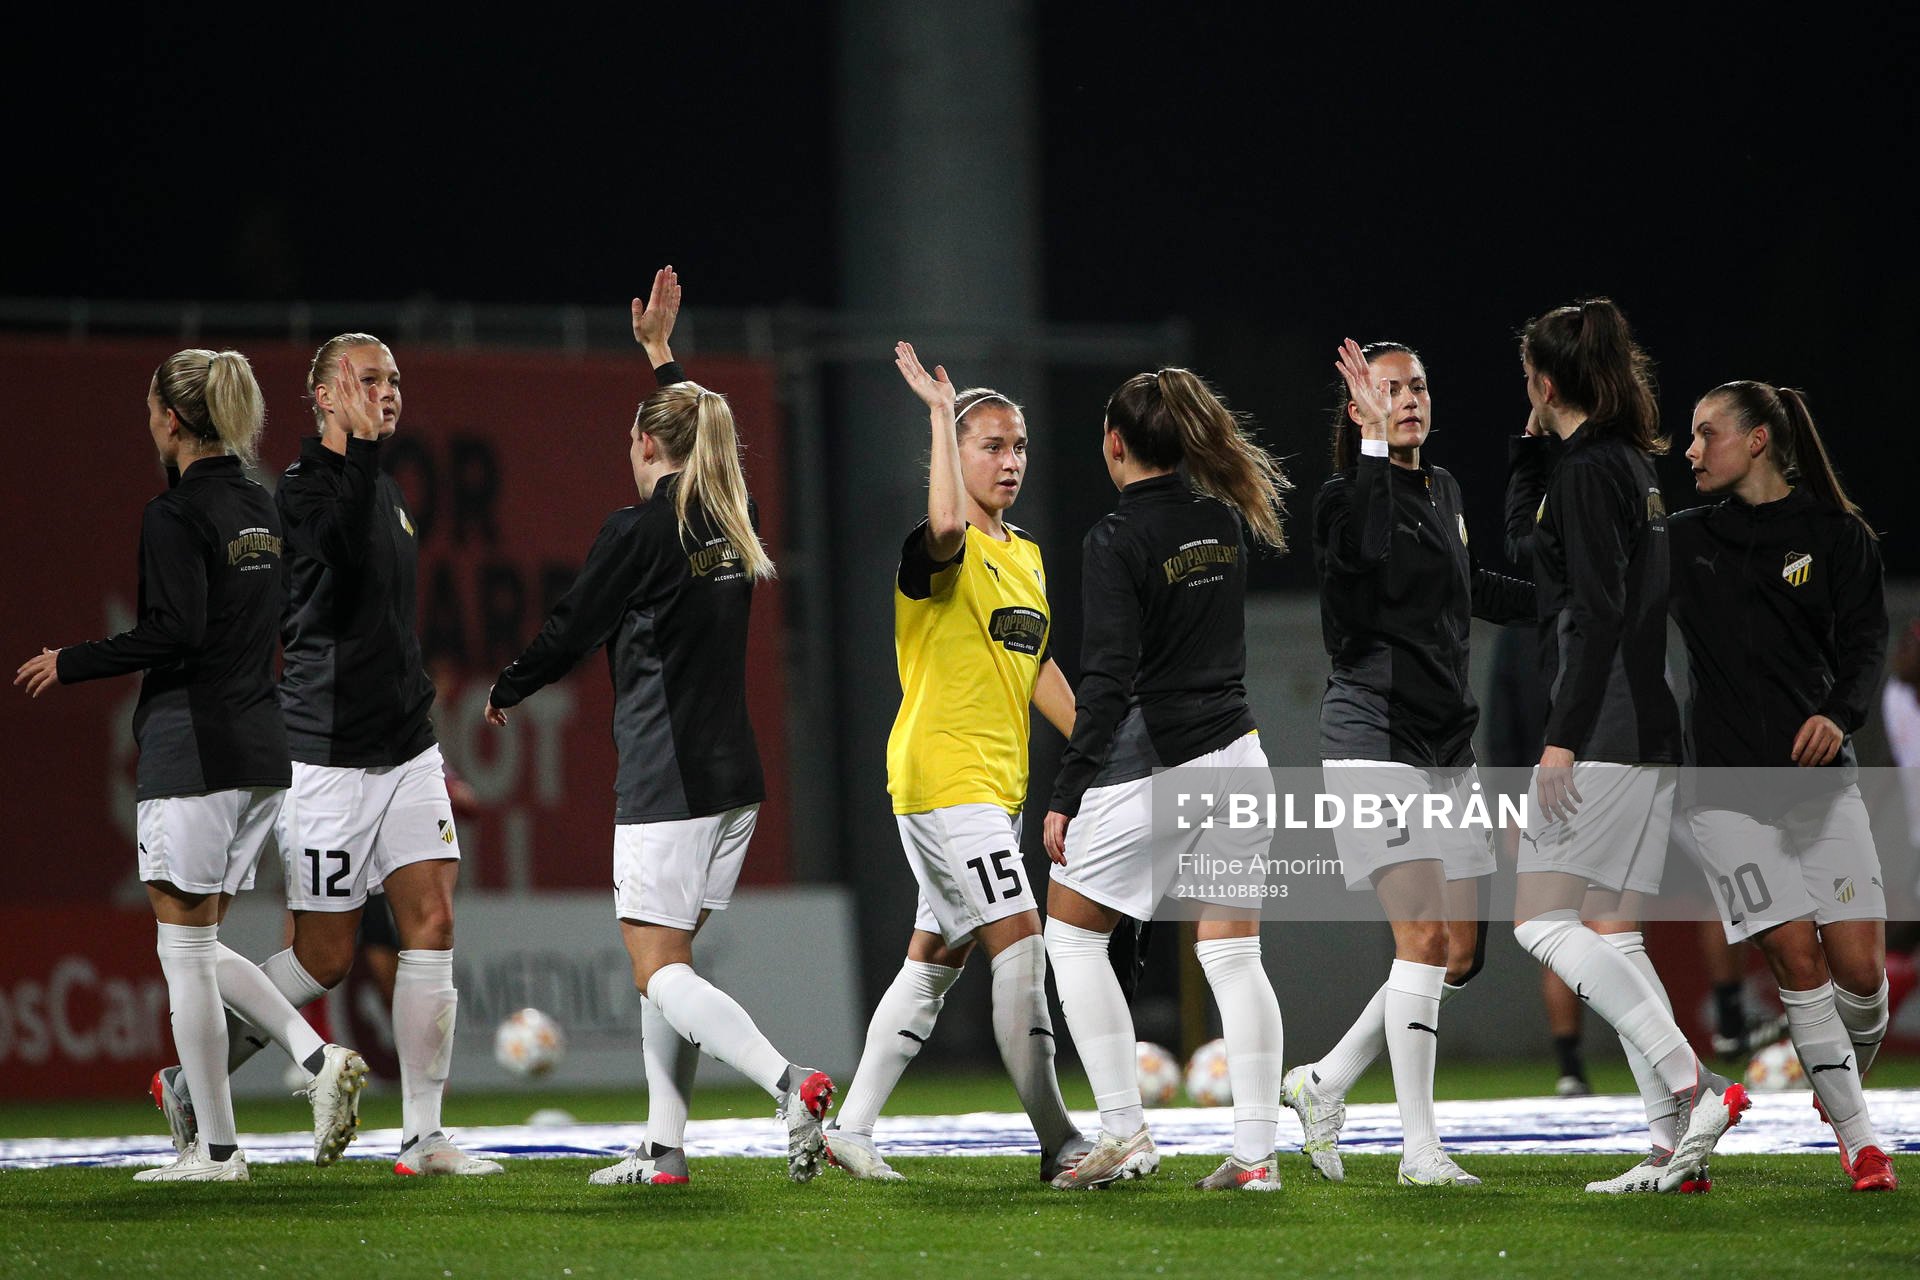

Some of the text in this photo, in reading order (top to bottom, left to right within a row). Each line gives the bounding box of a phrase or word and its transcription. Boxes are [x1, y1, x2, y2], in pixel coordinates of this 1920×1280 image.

[304, 848, 350, 897] 12
[966, 849, 1022, 904] 15
[1718, 862, 1773, 926] 20
